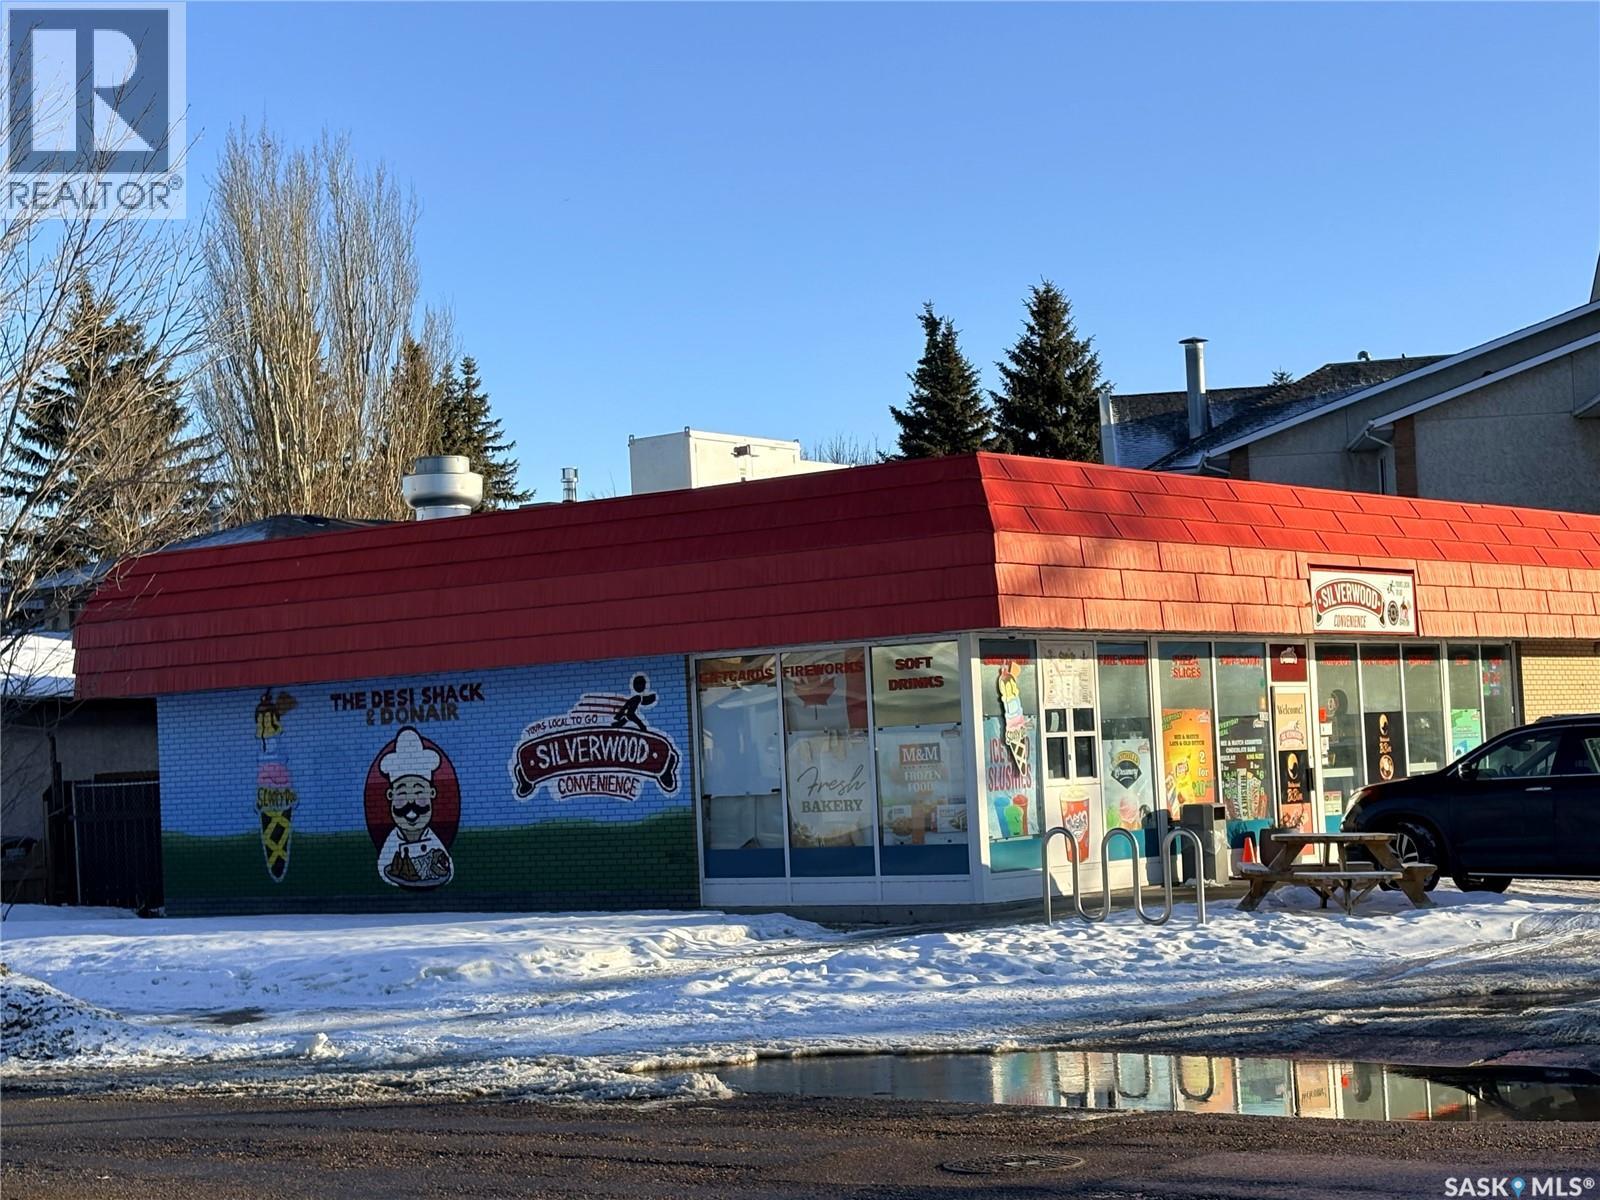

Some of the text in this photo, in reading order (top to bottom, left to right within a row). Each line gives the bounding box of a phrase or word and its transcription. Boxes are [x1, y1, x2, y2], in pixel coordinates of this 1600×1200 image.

[1321, 582, 1378, 610] SILVERWOOD
[1334, 614, 1367, 628] CONVENIENCE
[783, 661, 865, 679] FIREWORKS
[895, 656, 934, 671] SOFT
[698, 666, 775, 685] GIFTCARDS
[888, 675, 944, 691] DRINKS
[330, 682, 486, 712] THE DESI SHACK
[380, 703, 461, 725] DONAIR
[548, 718, 570, 729] LOCAL
[570, 716, 582, 725] TO
[585, 714, 598, 724] GO
[536, 734, 650, 769] SILVERWOOD
[901, 746, 938, 762] M&M
[1199, 751, 1206, 764] 2
[797, 764, 867, 797] Fresh
[904, 770, 942, 781] FROZEN
[557, 773, 640, 798] CONVENIENCE
[907, 782, 934, 793] FOOD
[801, 799, 864, 813] BAKERY
